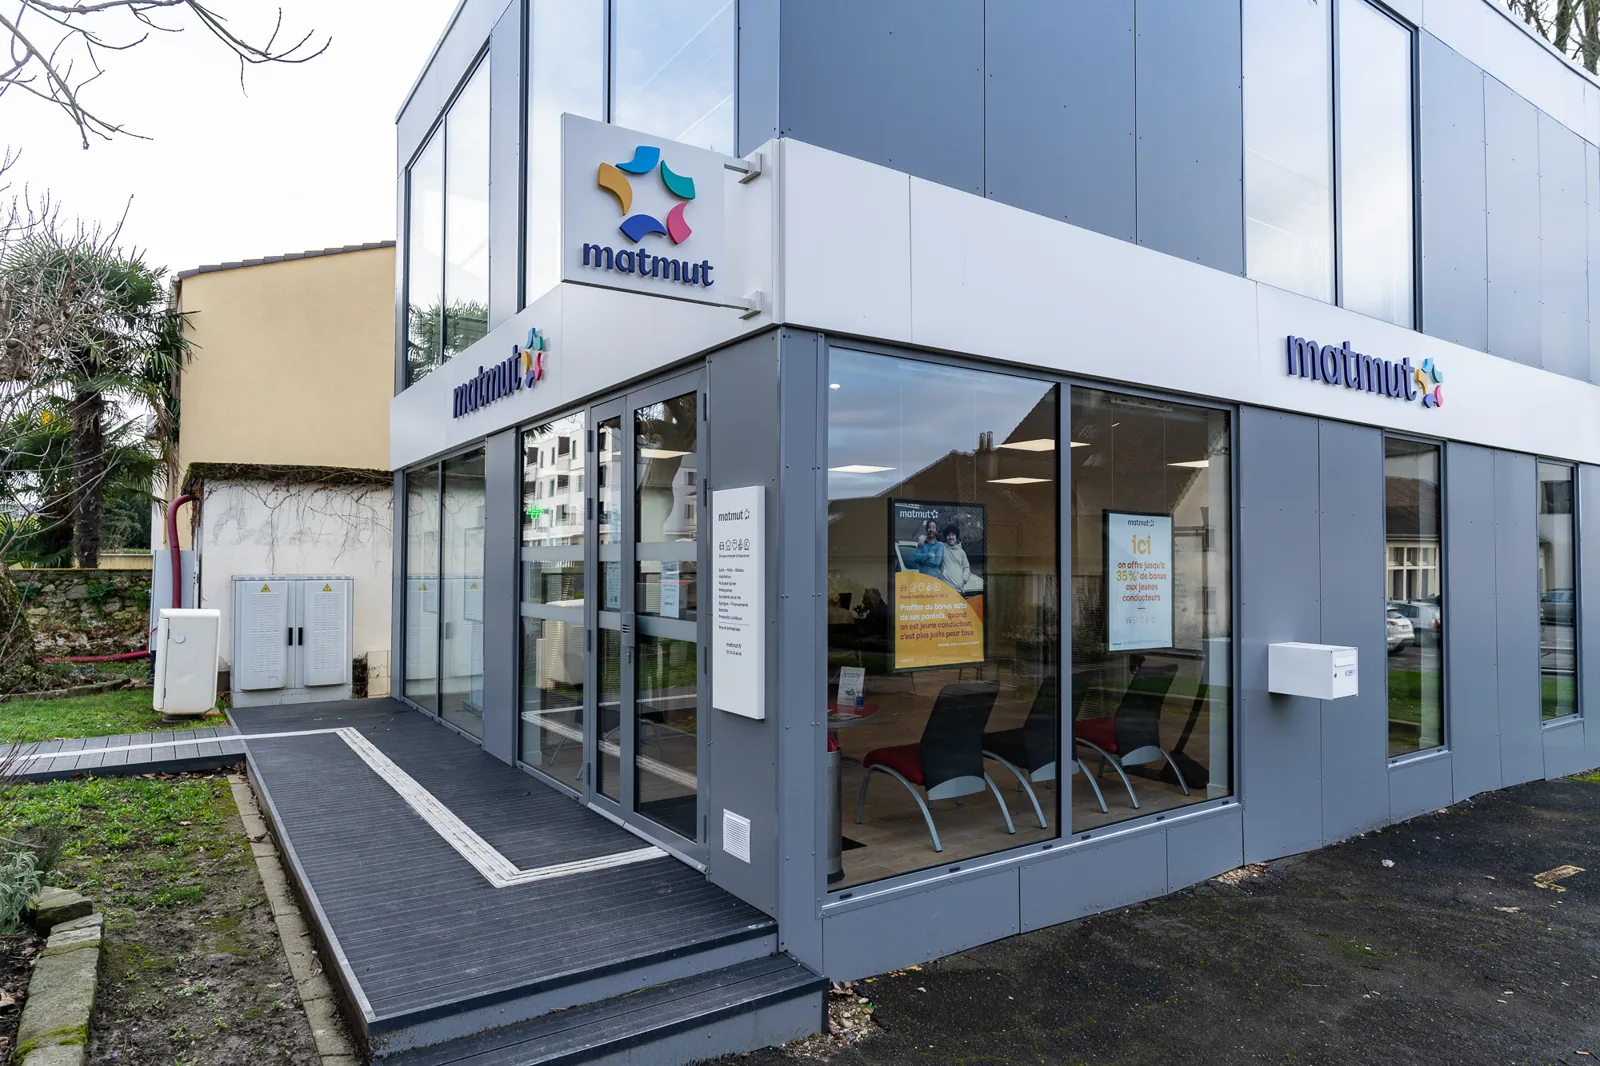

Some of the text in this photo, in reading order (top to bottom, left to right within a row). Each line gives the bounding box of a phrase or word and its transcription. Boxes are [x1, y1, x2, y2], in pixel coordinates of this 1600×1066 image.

[583, 243, 714, 286] matmut
[1287, 335, 1417, 401] matmut
[453, 345, 521, 418] matmut
[718, 509, 743, 521] matmut
[900, 509, 930, 518] matmut
[1128, 519, 1149, 527] matmut
[1132, 534, 1151, 554] ici
[1127, 561, 1143, 569] offre
[1116, 570, 1127, 581] 35
[1140, 572, 1148, 580] de
[1138, 583, 1158, 592] jeunes
[947, 612, 966, 620] quand
[919, 622, 937, 631] jeune
[916, 632, 929, 640] plus
[929, 631, 945, 639] juste
